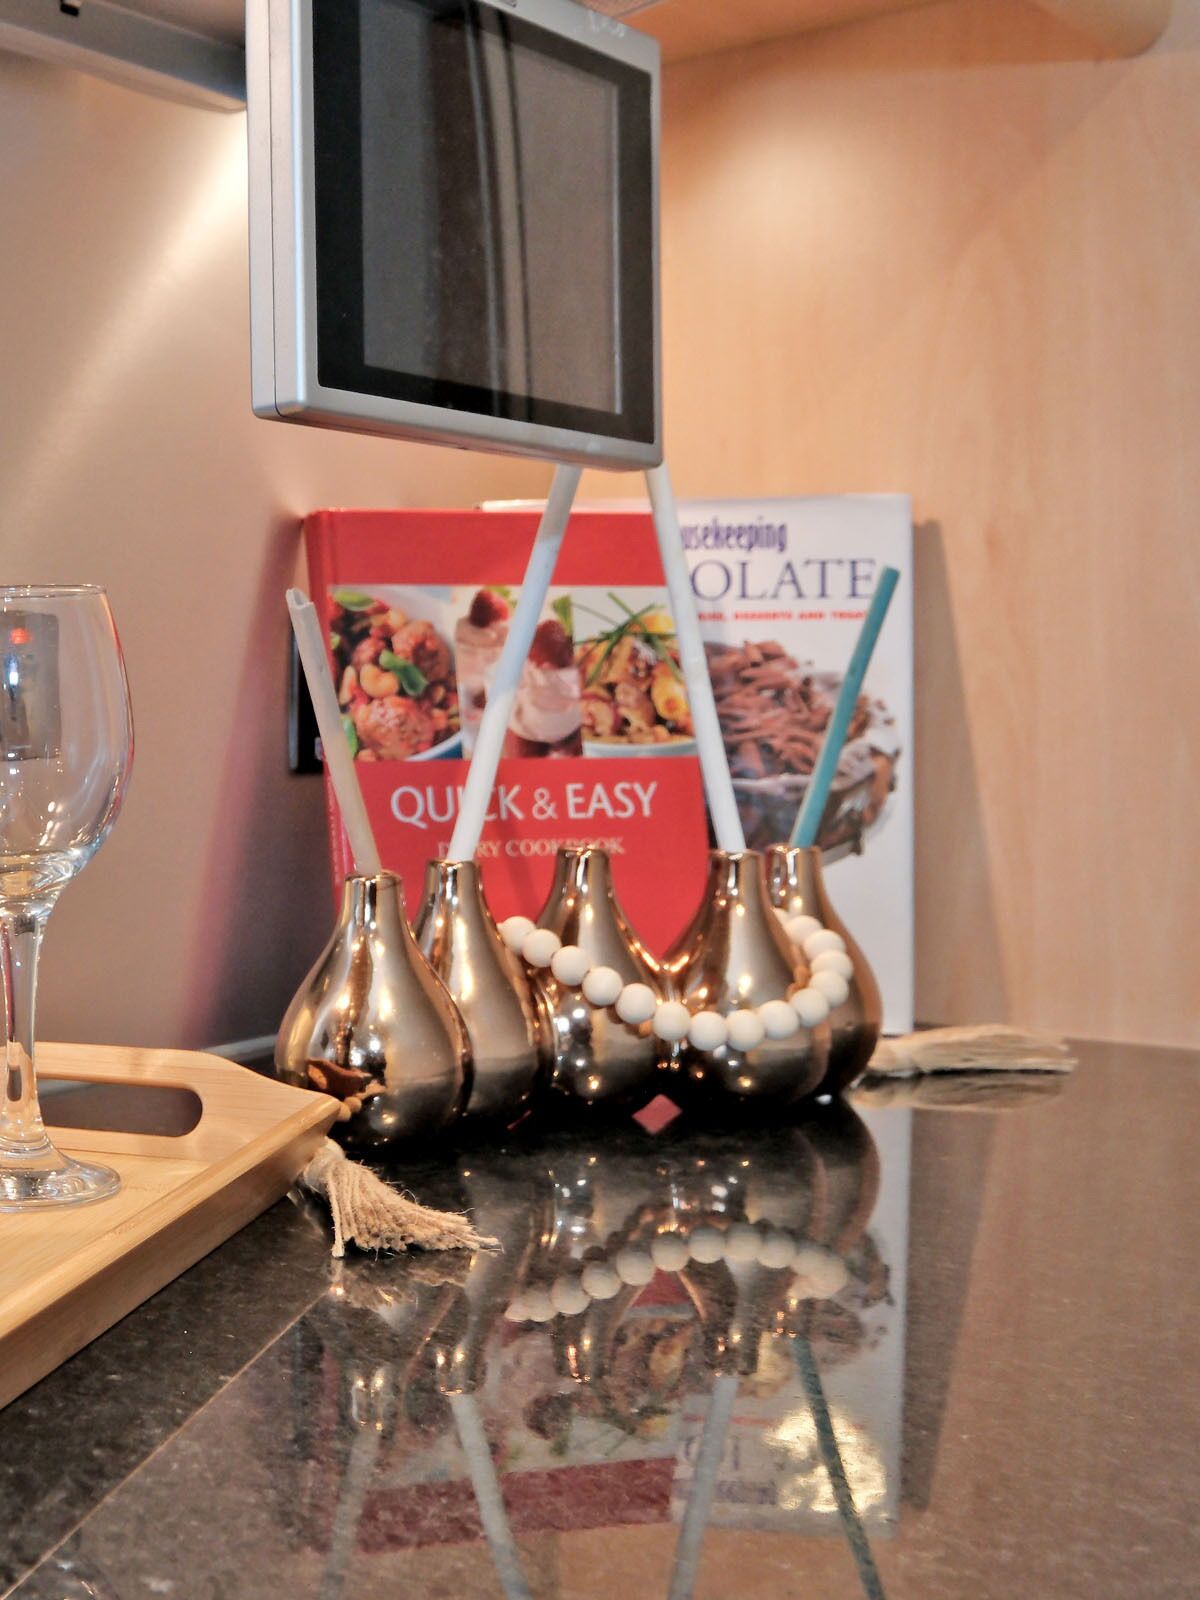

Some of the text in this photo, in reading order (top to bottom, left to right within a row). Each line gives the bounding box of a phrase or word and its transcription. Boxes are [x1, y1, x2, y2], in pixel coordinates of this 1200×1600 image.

[688, 556, 877, 601] OLATE
[531, 786, 558, 820] &
[565, 781, 658, 819] EASY
